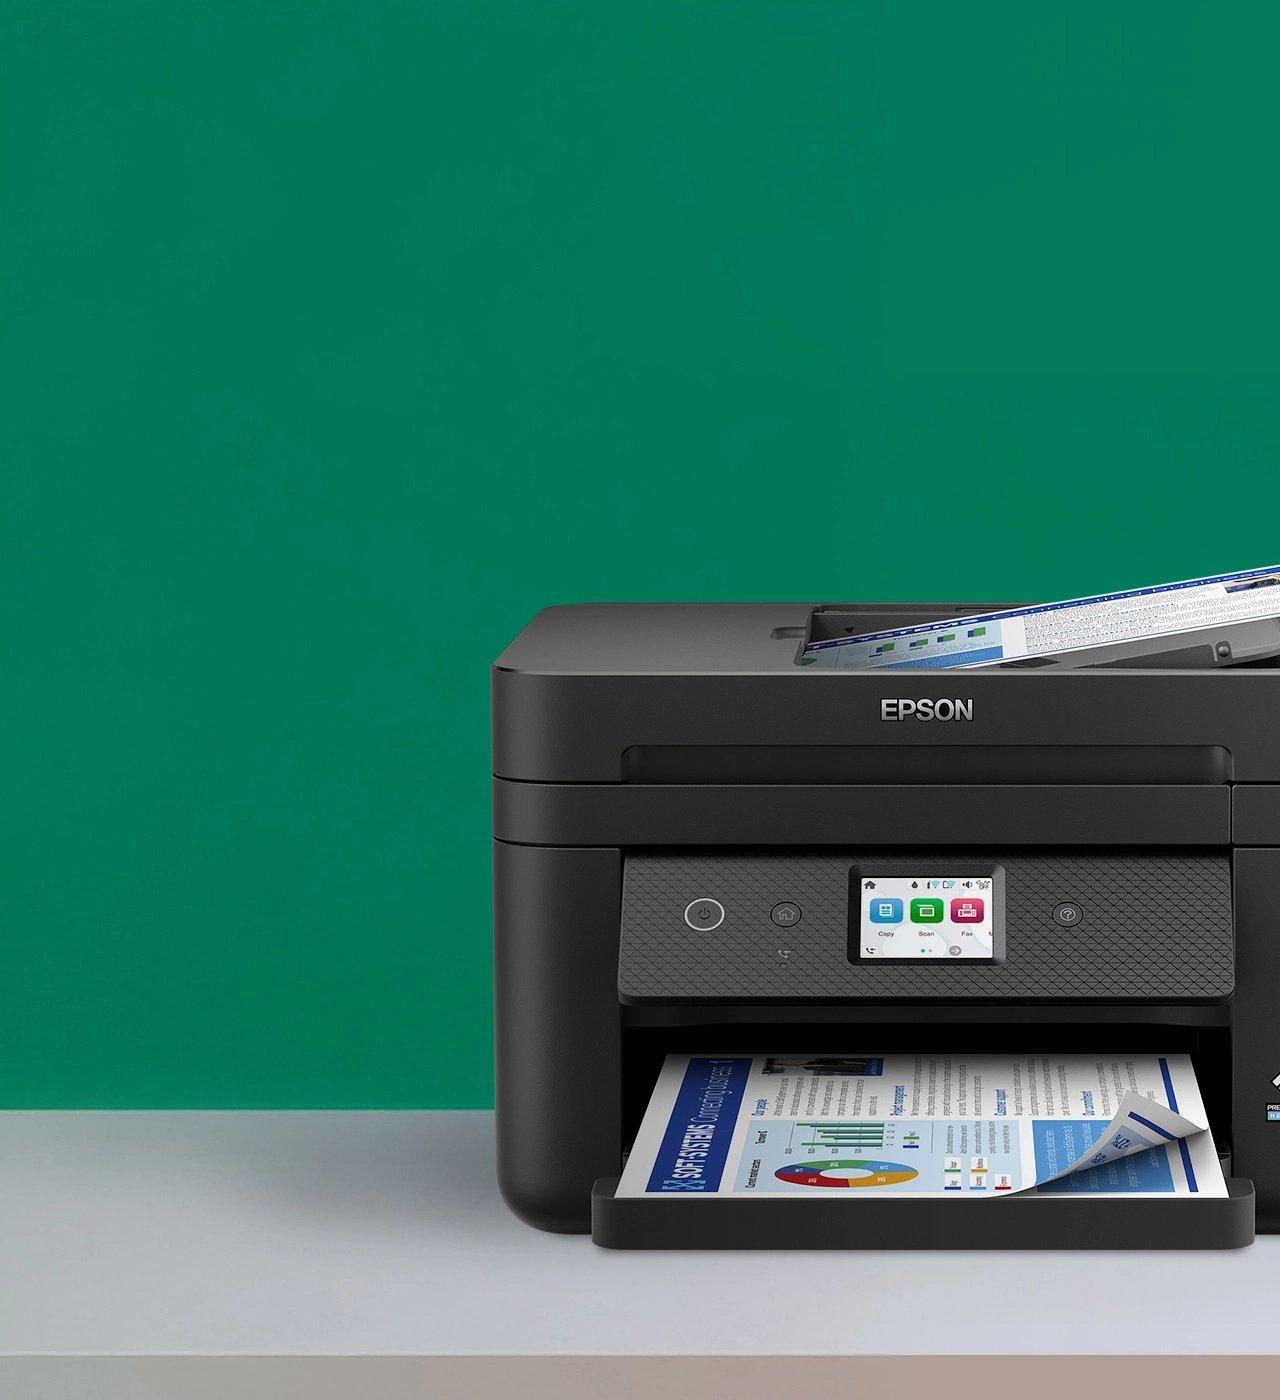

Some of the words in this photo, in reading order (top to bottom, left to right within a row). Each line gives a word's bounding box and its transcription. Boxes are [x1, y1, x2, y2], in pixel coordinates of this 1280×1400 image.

[881, 699, 972, 721] EPSON
[700, 1067, 732, 1089] business
[690, 1091, 732, 1123] Connecting
[672, 1124, 716, 1178] SOFT-SYSTEMS
